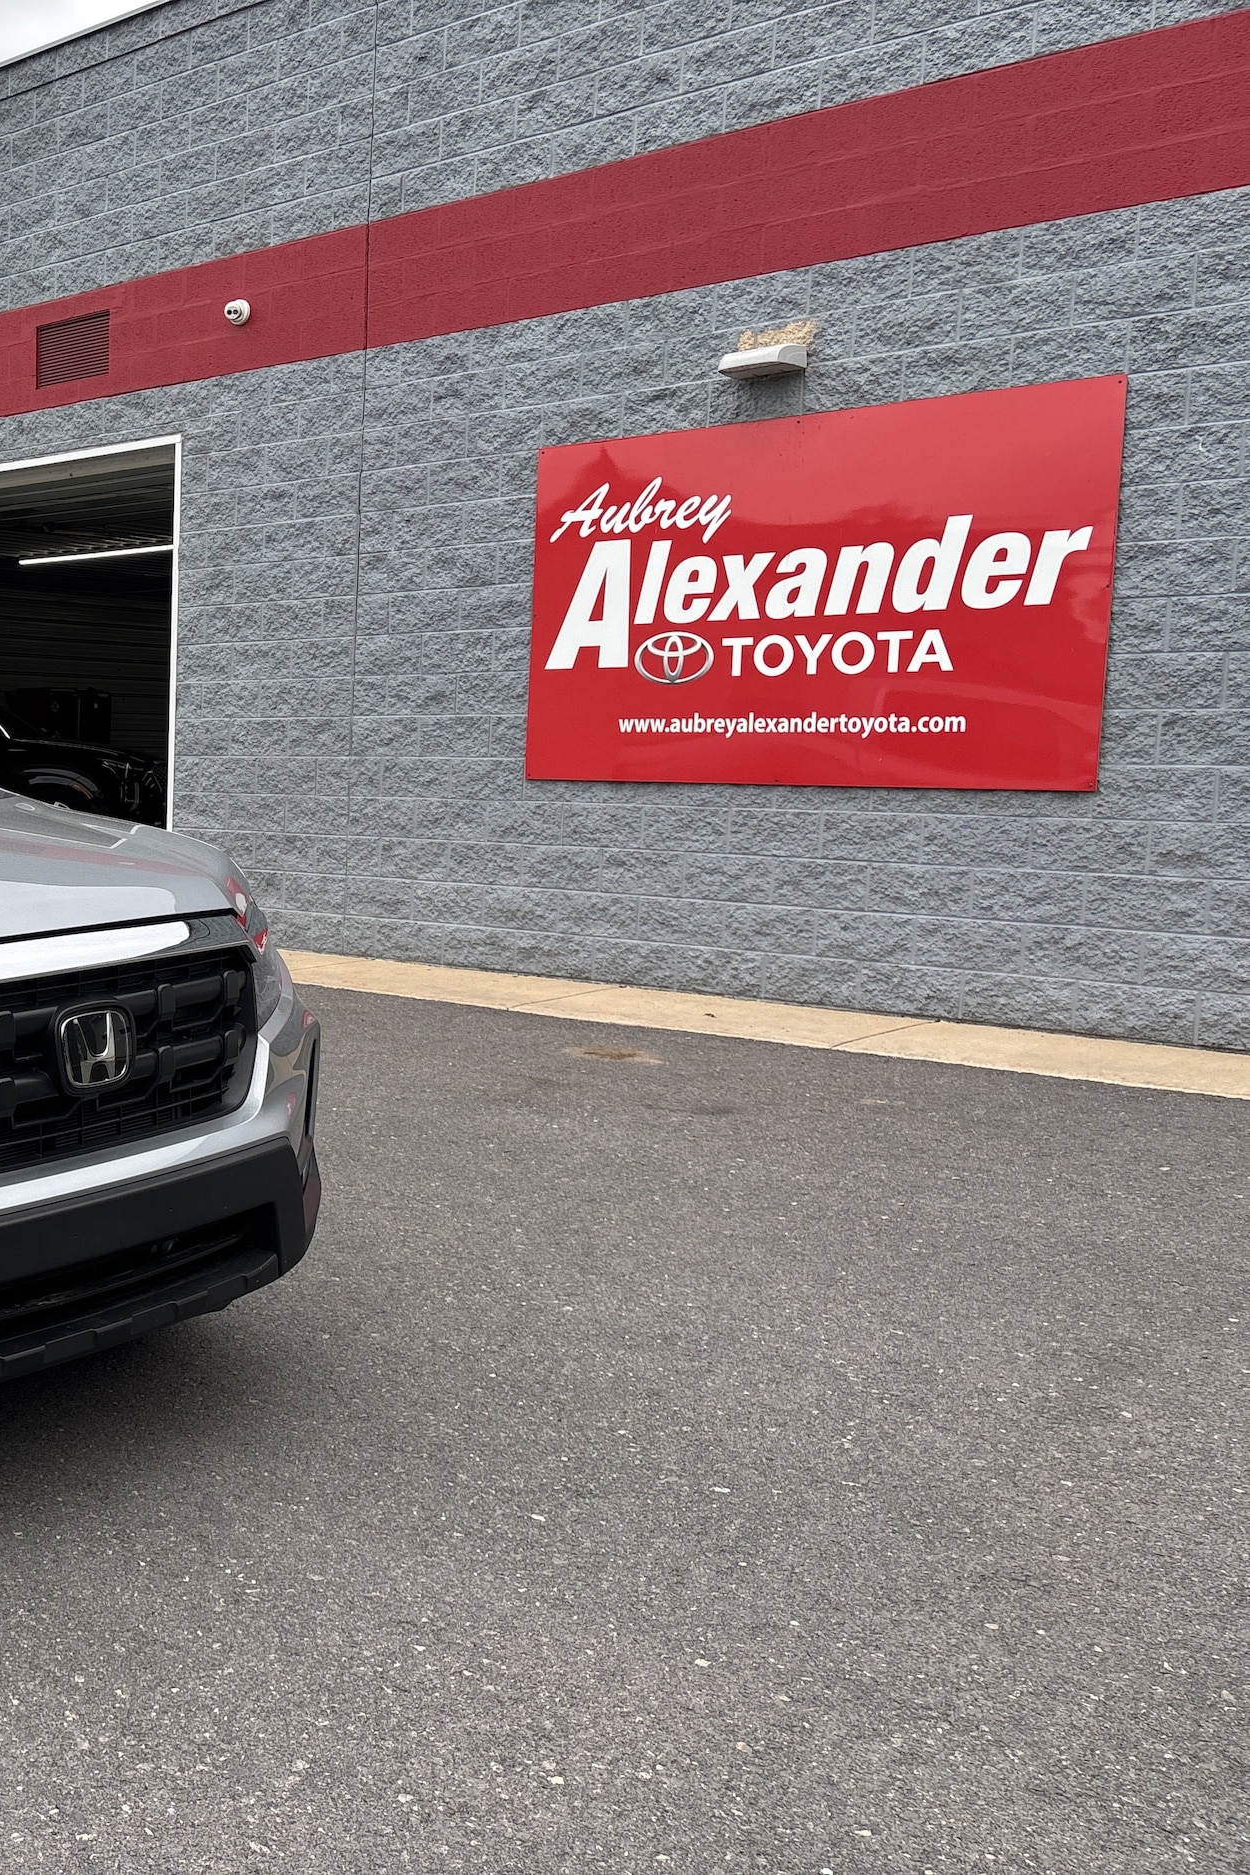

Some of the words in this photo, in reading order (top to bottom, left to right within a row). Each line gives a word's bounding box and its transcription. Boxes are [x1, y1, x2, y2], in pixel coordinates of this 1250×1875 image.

[549, 476, 732, 543] Aubrey
[544, 514, 1094, 670] Alexander
[721, 629, 954, 677] TOYOTA
[618, 711, 966, 739] www.aubreyalexandertoyota.com
